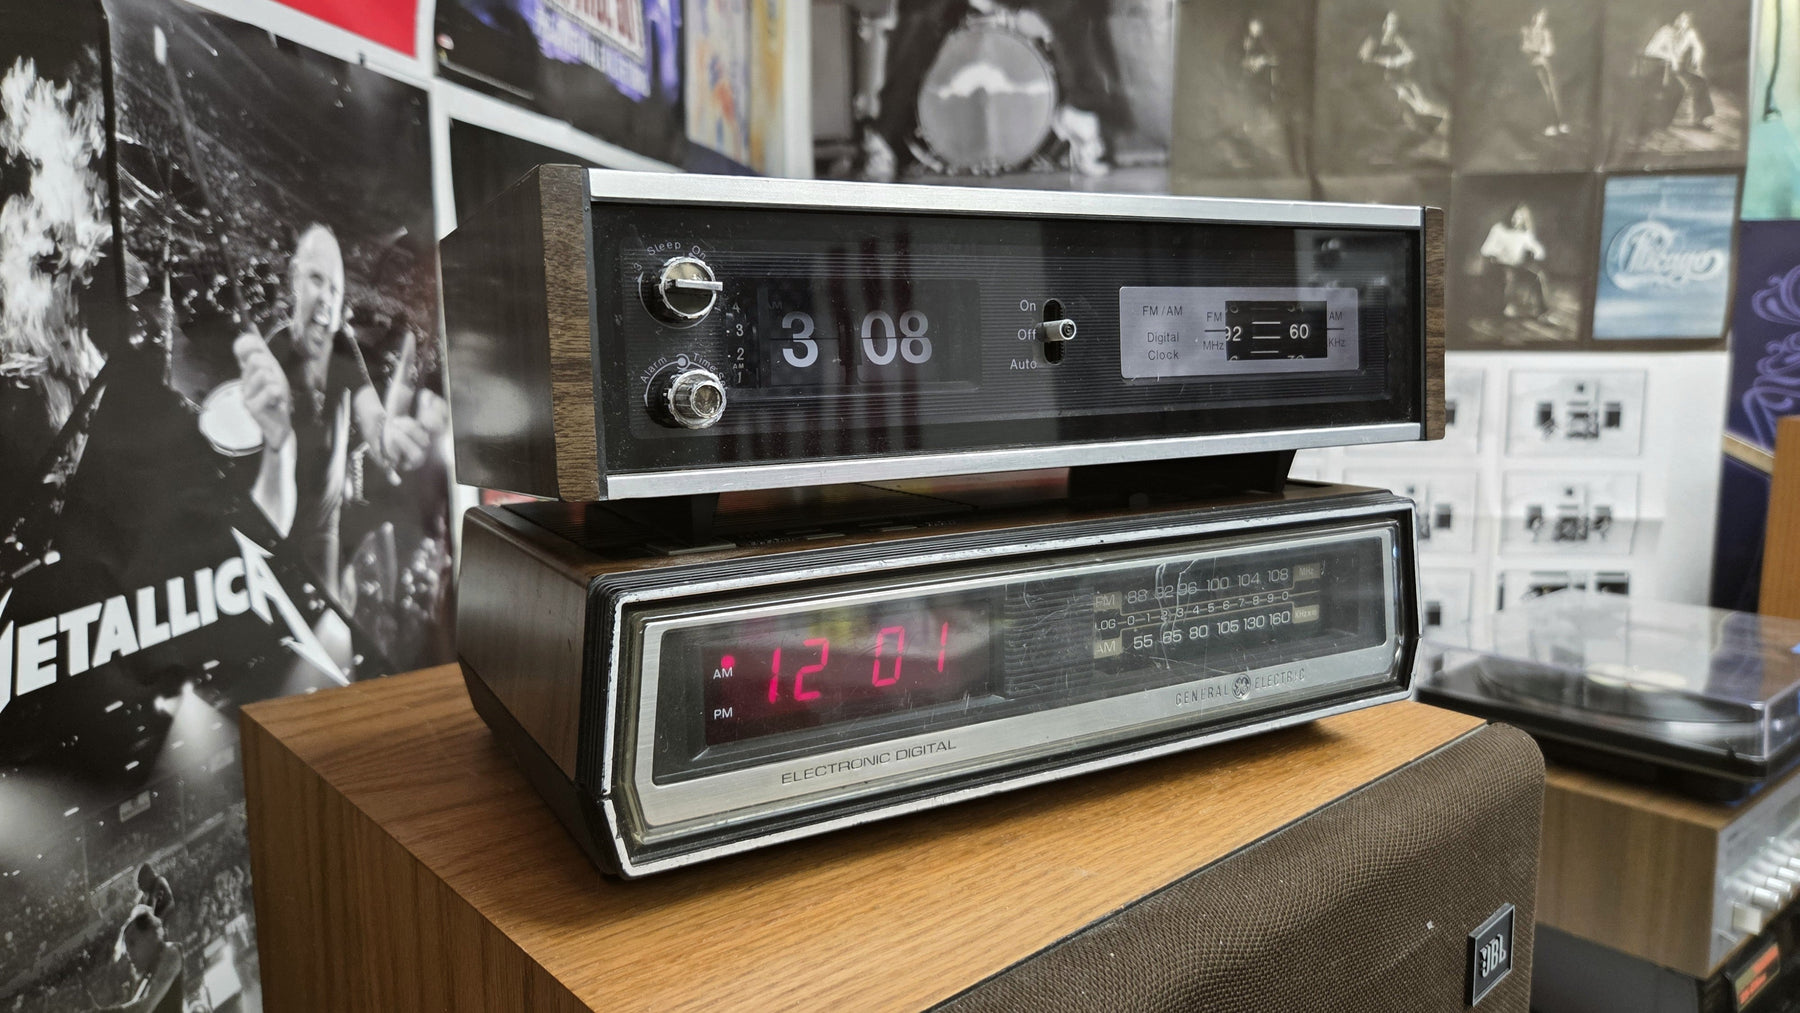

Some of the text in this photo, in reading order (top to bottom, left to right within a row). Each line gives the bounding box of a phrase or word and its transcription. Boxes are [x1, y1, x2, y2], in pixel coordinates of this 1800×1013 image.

[647, 240, 706, 260] Sleep On
[1607, 220, 1725, 291] Chicago
[1019, 299, 1037, 312] On
[1206, 311, 1223, 322] FM
[1328, 311, 1343, 321] AM
[736, 324, 744, 336] 3
[1017, 328, 1037, 342] Off
[1225, 326, 1242, 342] 92
[1289, 324, 1309, 339] 60
[781, 310, 933, 368] 3 08
[1146, 331, 1180, 345] Digital
[1328, 338, 1346, 348] KHz
[736, 347, 745, 361] 2
[1202, 341, 1225, 352] MHz
[692, 352, 718, 373] Time
[1147, 349, 1180, 362] Clock
[640, 355, 668, 384] Alarm
[732, 362, 745, 370] AM
[1010, 357, 1038, 371] Auto
[1127, 588, 1148, 604] 88
[1206, 577, 1229, 592] 100
[1237, 572, 1260, 587] 104
[1268, 568, 1289, 583] 108
[1094, 618, 1116, 631] LOG
[1192, 605, 1200, 615] 4
[1207, 602, 1215, 613] 5
[1222, 600, 1230, 610] 6
[1238, 598, 1246, 608] 7
[1252, 596, 1260, 606] 8
[1266, 593, 1274, 603] 9
[0, 527, 349, 714] ETALLICA
[1096, 639, 1116, 654] AM
[1133, 633, 1153, 650] 55
[1189, 625, 1208, 640] 80
[1217, 619, 1239, 635] 105
[1243, 614, 1265, 631] 130
[1268, 611, 1291, 627] 160
[769, 621, 949, 704] 12 01
[712, 666, 733, 680] AM
[1175, 683, 1229, 706] GENERAL
[1254, 667, 1305, 690] ELECTRIC
[712, 706, 733, 720] PM
[780, 739, 957, 785] ELECTRONIC DIGITAL
[1480, 933, 1507, 978] JBL
